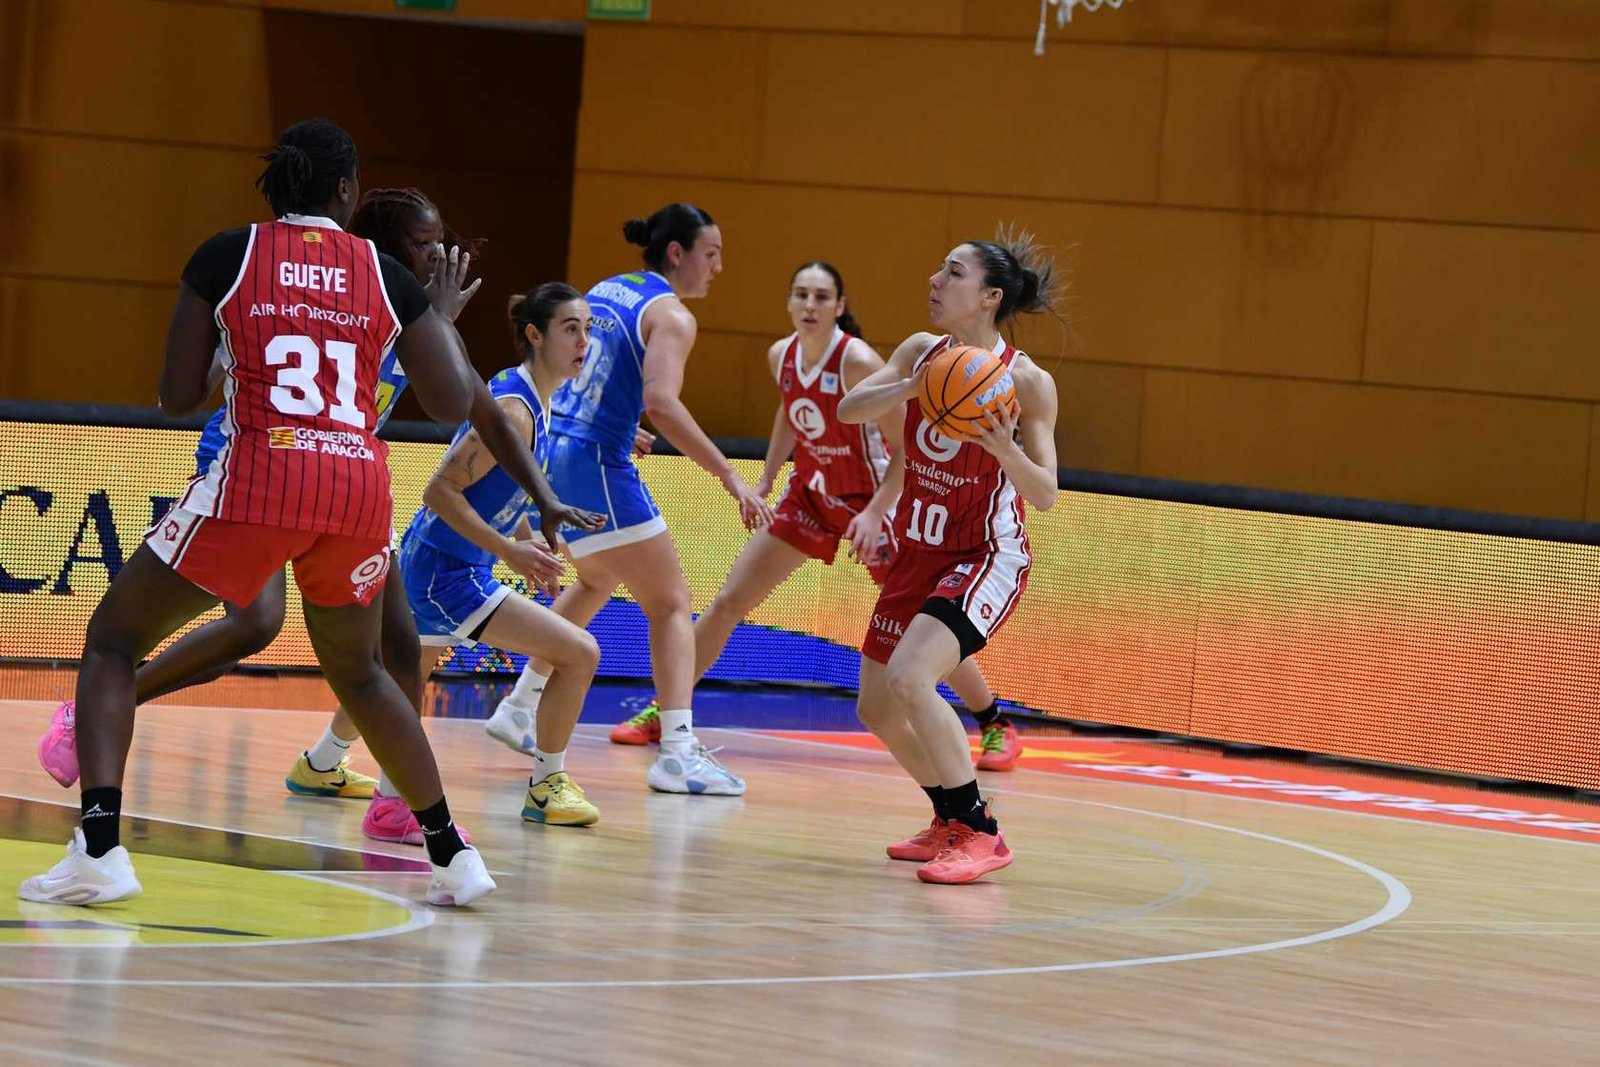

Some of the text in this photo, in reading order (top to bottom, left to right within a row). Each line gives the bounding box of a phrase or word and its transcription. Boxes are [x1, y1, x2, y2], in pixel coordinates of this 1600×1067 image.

[279, 261, 347, 293] GUEYE
[250, 303, 370, 330] AIR HORIZONT
[265, 335, 366, 429] 31
[296, 427, 365, 446] GOBIERNO
[296, 439, 317, 452] DE
[906, 498, 949, 546] 10
